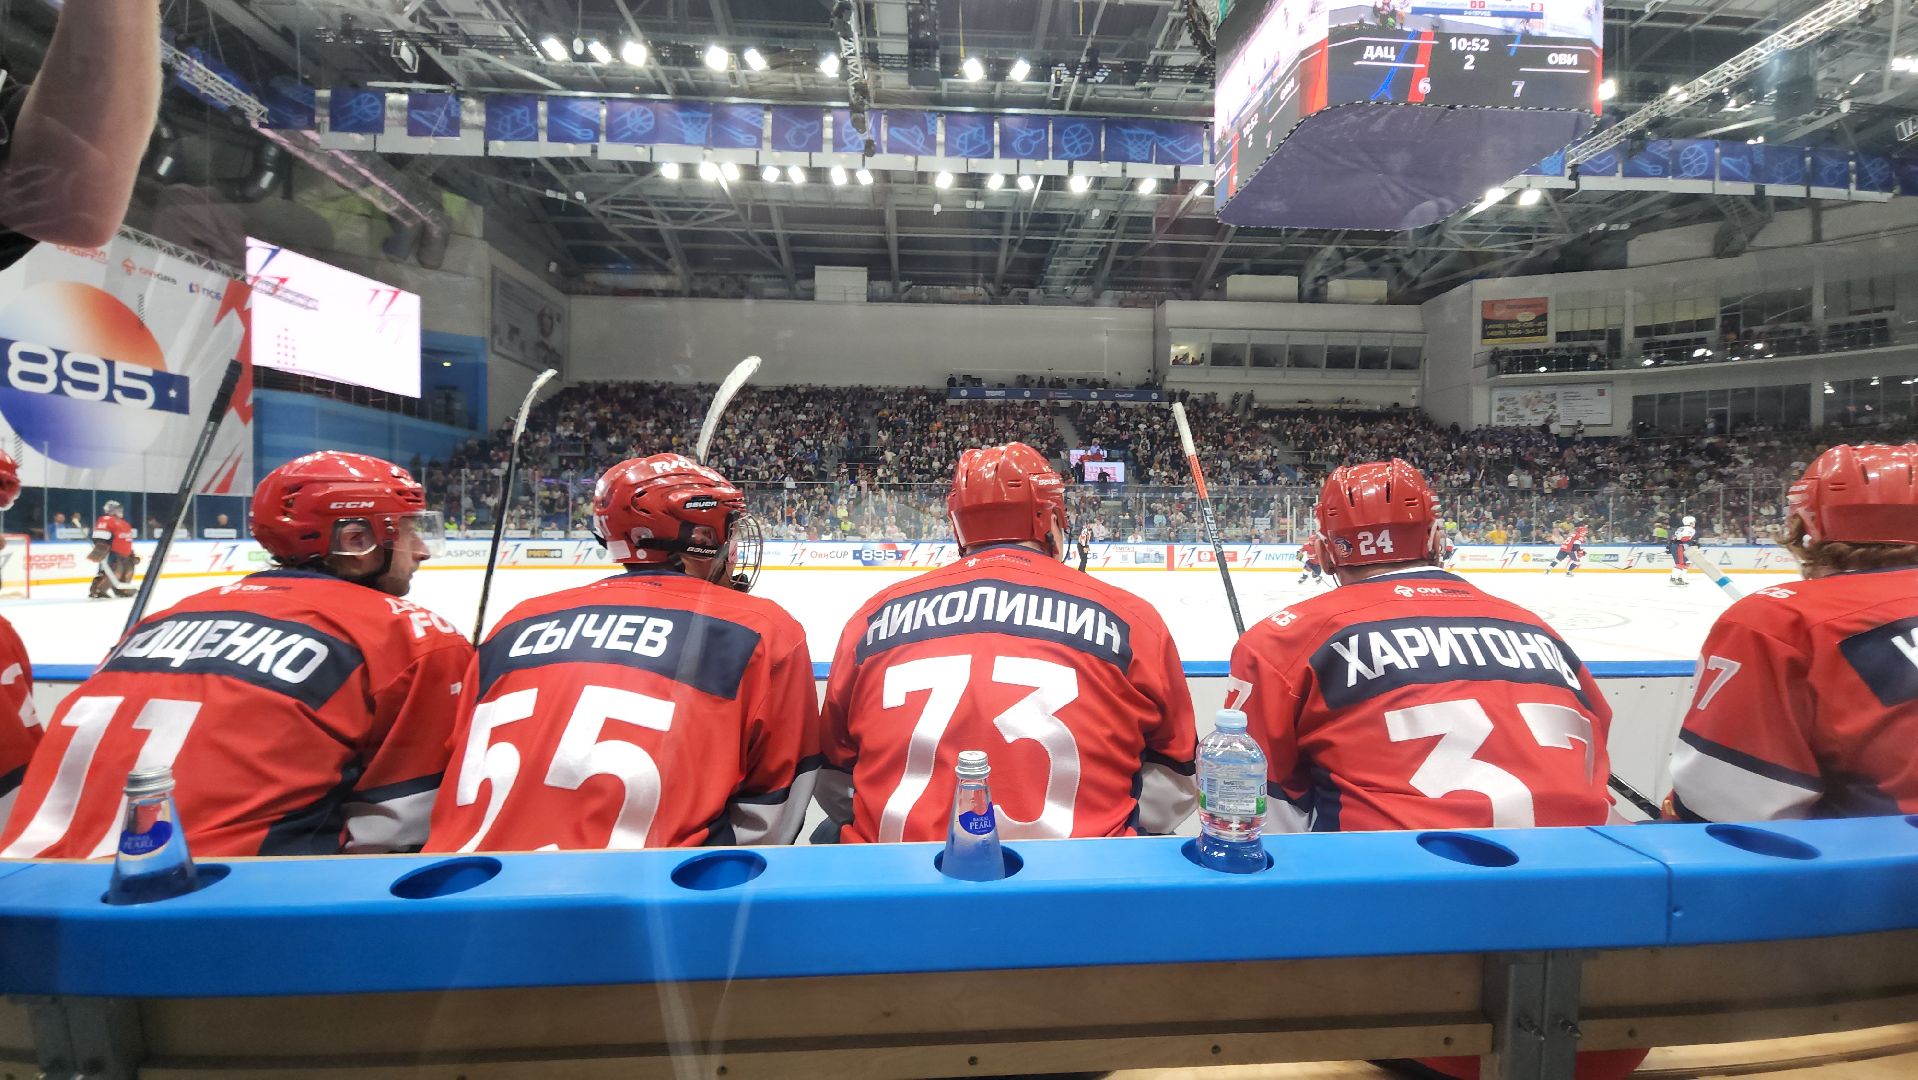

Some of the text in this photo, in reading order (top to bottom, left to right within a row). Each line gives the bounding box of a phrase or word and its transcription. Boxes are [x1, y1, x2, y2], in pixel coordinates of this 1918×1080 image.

[1363, 45, 1396, 61] ДАЦ
[1450, 37, 1490, 52] 10:52
[1464, 54, 1476, 70] 2
[1547, 53, 1579, 66] ОВИ
[1418, 77, 1432, 95] 6
[1511, 80, 1526, 98] 7
[8, 340, 155, 411] 895
[330, 501, 375, 509] CCM
[685, 501, 718, 509] BAUER
[686, 546, 718, 555] BAUER
[1357, 529, 1394, 556] 24
[861, 550, 897, 561] 895
[1086, 552, 1098, 560] СБ
[1265, 553, 1296, 561] INVITR
[865, 578, 1122, 655] НИКОЛИШИН
[508, 613, 675, 659] СЫЧЕВ
[96, 619, 330, 684] ОЩЕНКО
[1691, 652, 1743, 711] 7
[881, 654, 1081, 843] 73
[456, 684, 676, 853] 55
[1384, 698, 1594, 829] 37
[1, 696, 202, 859] 11
[969, 820, 992, 830] PEARL
